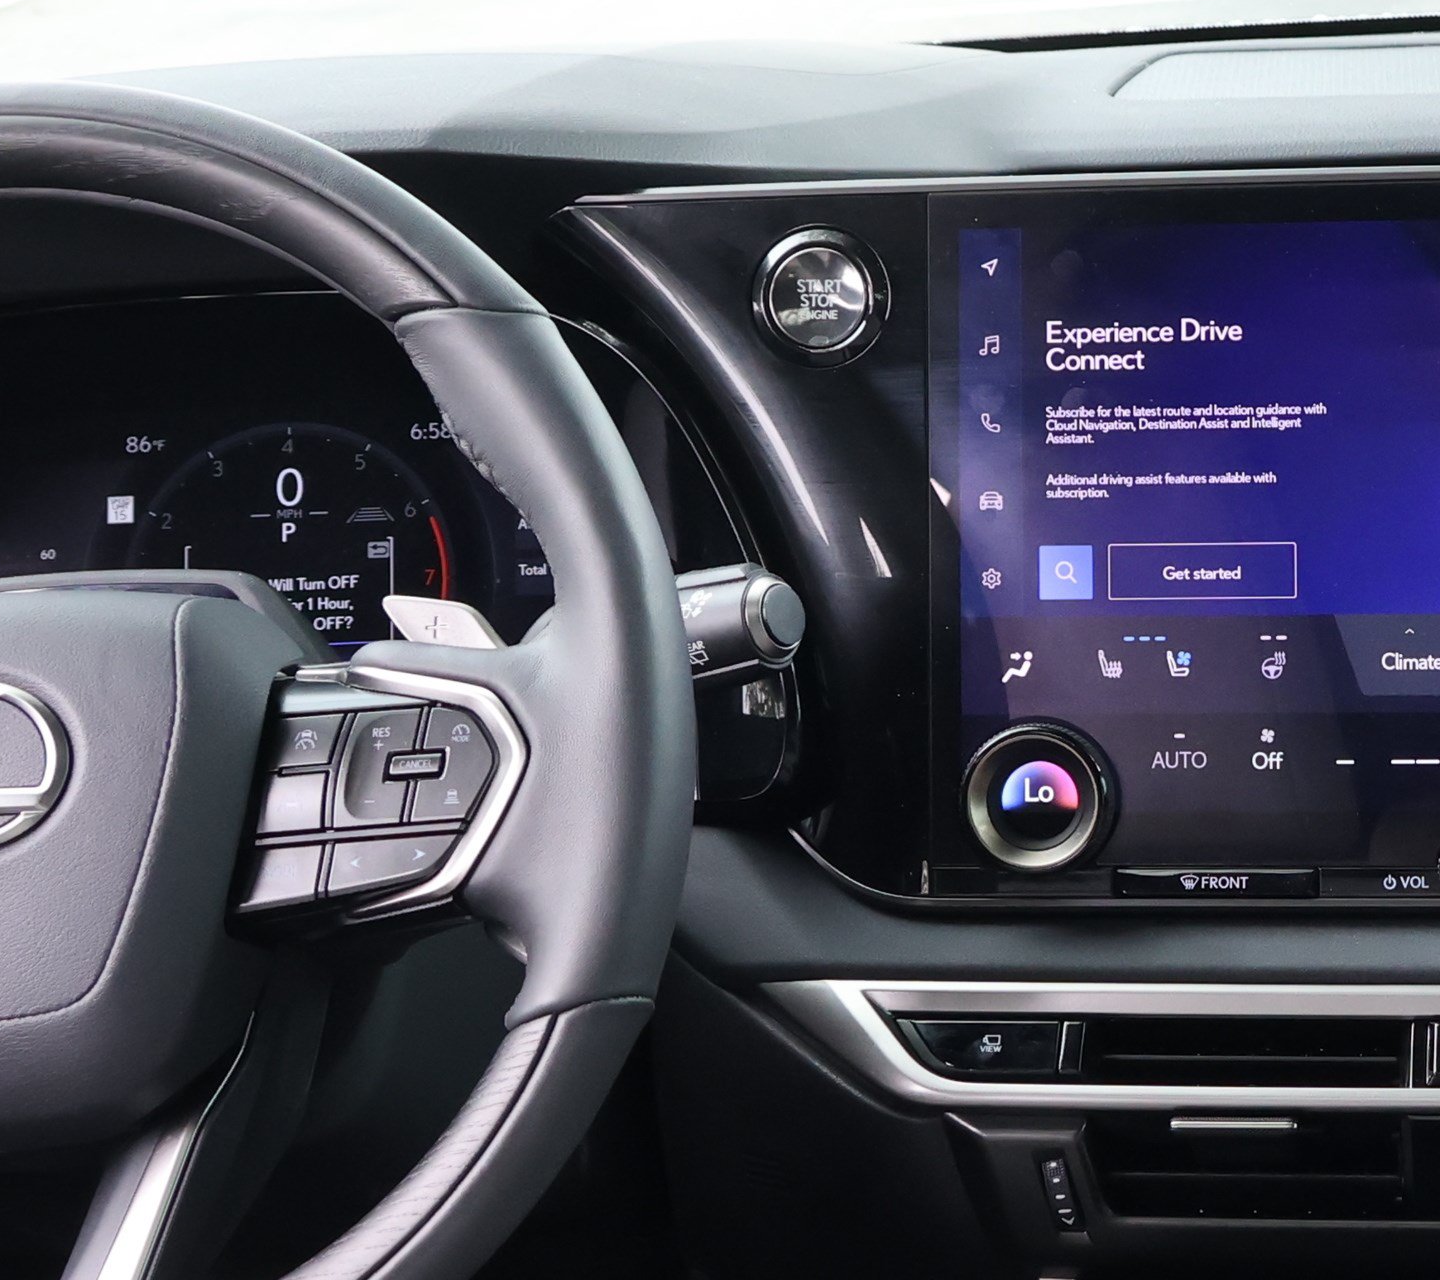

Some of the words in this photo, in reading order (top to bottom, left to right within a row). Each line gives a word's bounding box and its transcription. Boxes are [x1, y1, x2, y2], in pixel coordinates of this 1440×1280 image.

[796, 278, 842, 293] START
[800, 294, 837, 308] STOP
[799, 309, 839, 320] ENGINE
[1046, 320, 1174, 349] Experience
[1180, 317, 1243, 343] Drive
[1045, 347, 1145, 371] Connect
[1046, 407, 1095, 418] Subscribe
[1097, 406, 1111, 417] for
[1115, 406, 1130, 416] the
[1133, 406, 1161, 416] latest
[1163, 406, 1191, 416] route
[1194, 405, 1212, 415] and
[1214, 405, 1253, 415] location
[1256, 405, 1301, 418] guidance
[1304, 404, 1326, 414] with
[410, 422, 452, 441] 6:58
[1046, 420, 1077, 431] Cloud
[1079, 419, 1136, 433] Navigation,
[1138, 419, 1197, 430] Destination
[1199, 418, 1229, 429] Assist
[1231, 418, 1250, 428] and
[1252, 417, 1301, 430] Intelligent
[281, 438, 294, 454] 4
[1046, 433, 1094, 444] Assistant.
[212, 460, 223, 478] 3
[354, 453, 366, 471] 5
[276, 467, 304, 507] 0
[1046, 474, 1097, 486] Additional
[1099, 474, 1133, 487] driving
[1135, 473, 1162, 484] assist
[1165, 473, 1206, 484] features
[1209, 472, 1251, 483] available
[1253, 472, 1276, 483] with
[1046, 487, 1109, 500] subscription.
[276, 509, 303, 519] MPH
[404, 503, 417, 518] 6
[160, 513, 172, 530] 2
[281, 522, 297, 543] P
[40, 549, 57, 561] 60
[424, 568, 436, 586] 7
[518, 563, 547, 577] Total
[1162, 565, 1191, 581] Get
[1193, 565, 1241, 580] started
[268, 576, 294, 592] Will
[298, 576, 326, 591] Turn
[328, 575, 360, 589] OFF
[317, 596, 354, 612] Hour,
[313, 616, 354, 631] OFF?
[372, 727, 391, 738] RES
[398, 759, 434, 770] CANCEL
[1151, 751, 1208, 770] AUTO
[1251, 751, 1284, 770] Off
[1024, 777, 1055, 804] Lo
[1201, 876, 1249, 890] FRONT
[1400, 876, 1429, 890] VOL
